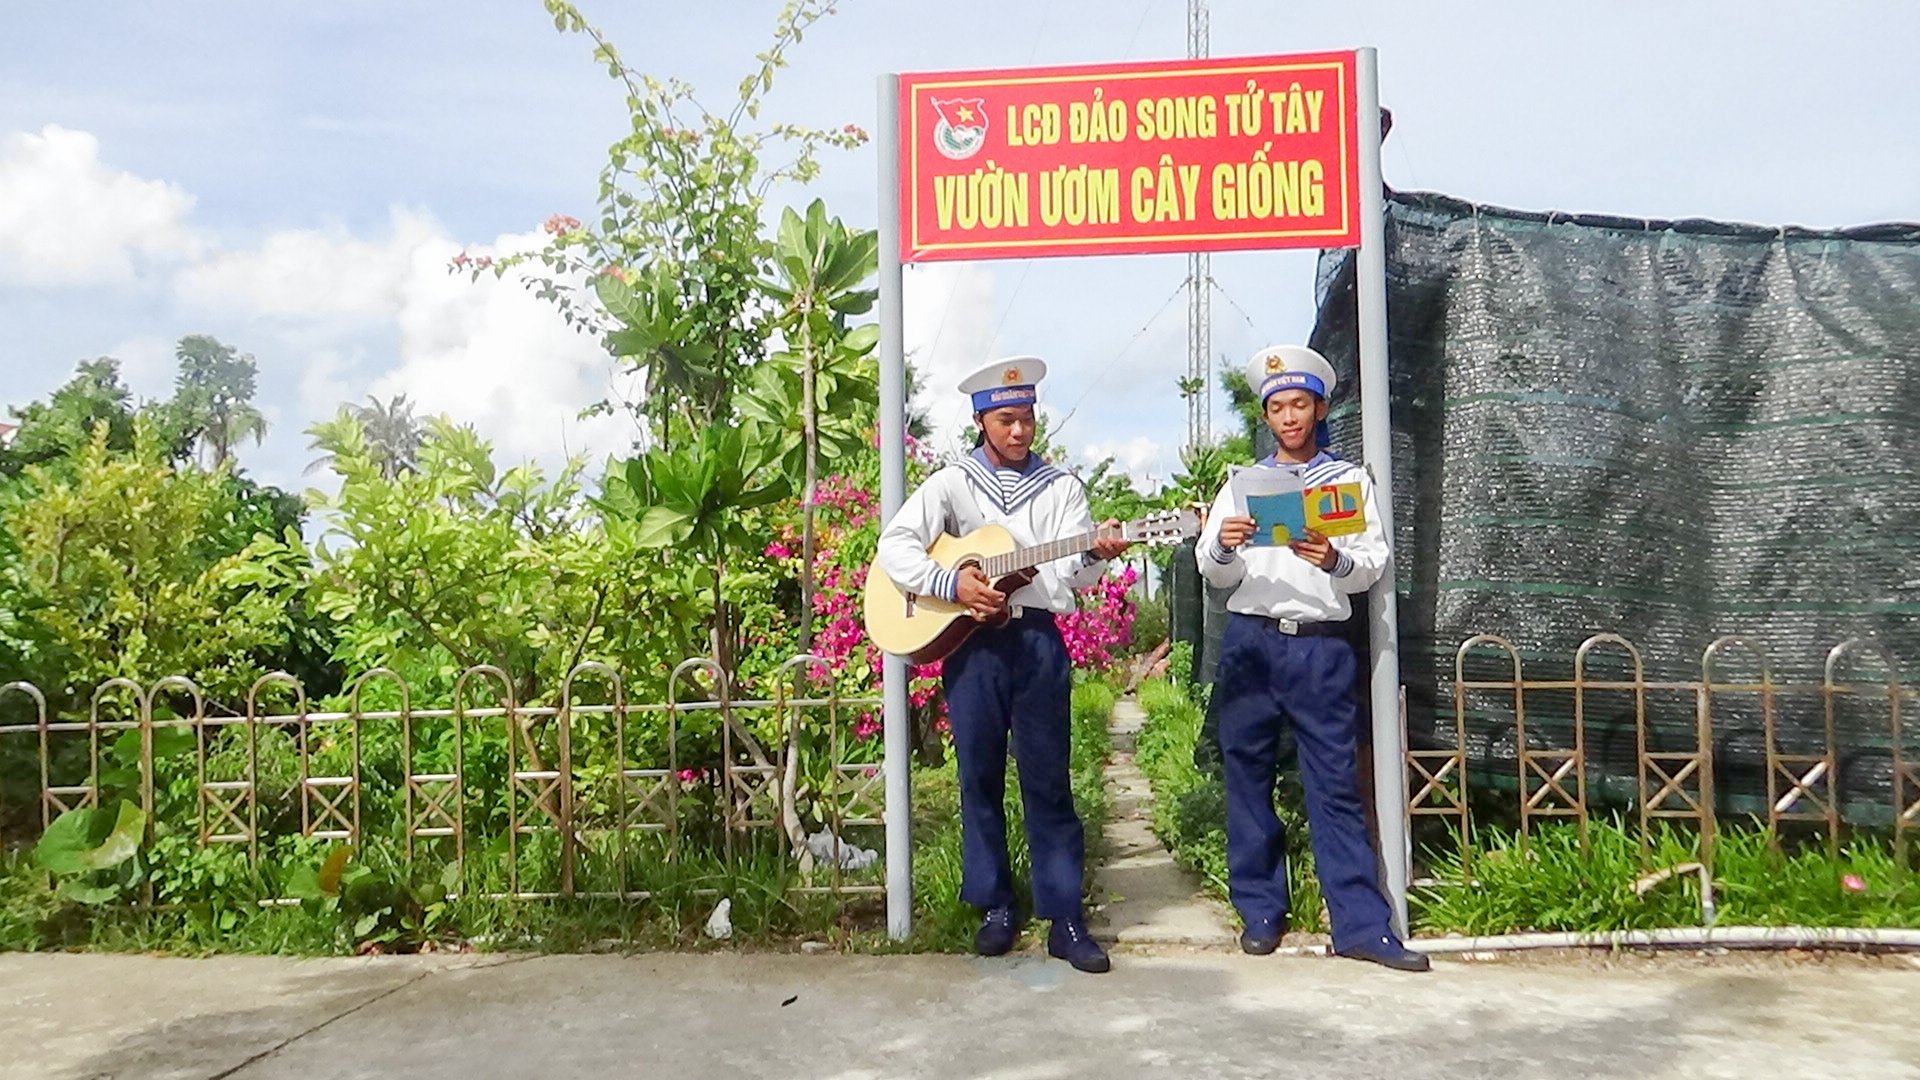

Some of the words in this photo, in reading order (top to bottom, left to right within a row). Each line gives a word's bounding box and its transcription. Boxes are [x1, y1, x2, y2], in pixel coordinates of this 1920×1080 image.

[1006, 104, 1061, 147] LCĐ
[1068, 87, 1128, 144] ĐẢO
[1136, 95, 1217, 141] SONG
[1224, 79, 1265, 137] TỬ
[1269, 82, 1325, 135] TÂY
[933, 160, 1029, 231] VƯỜN
[1039, 163, 1120, 227] ƯƠM
[1130, 154, 1202, 224] CÂY
[1212, 142, 1325, 221] GIỐNG
